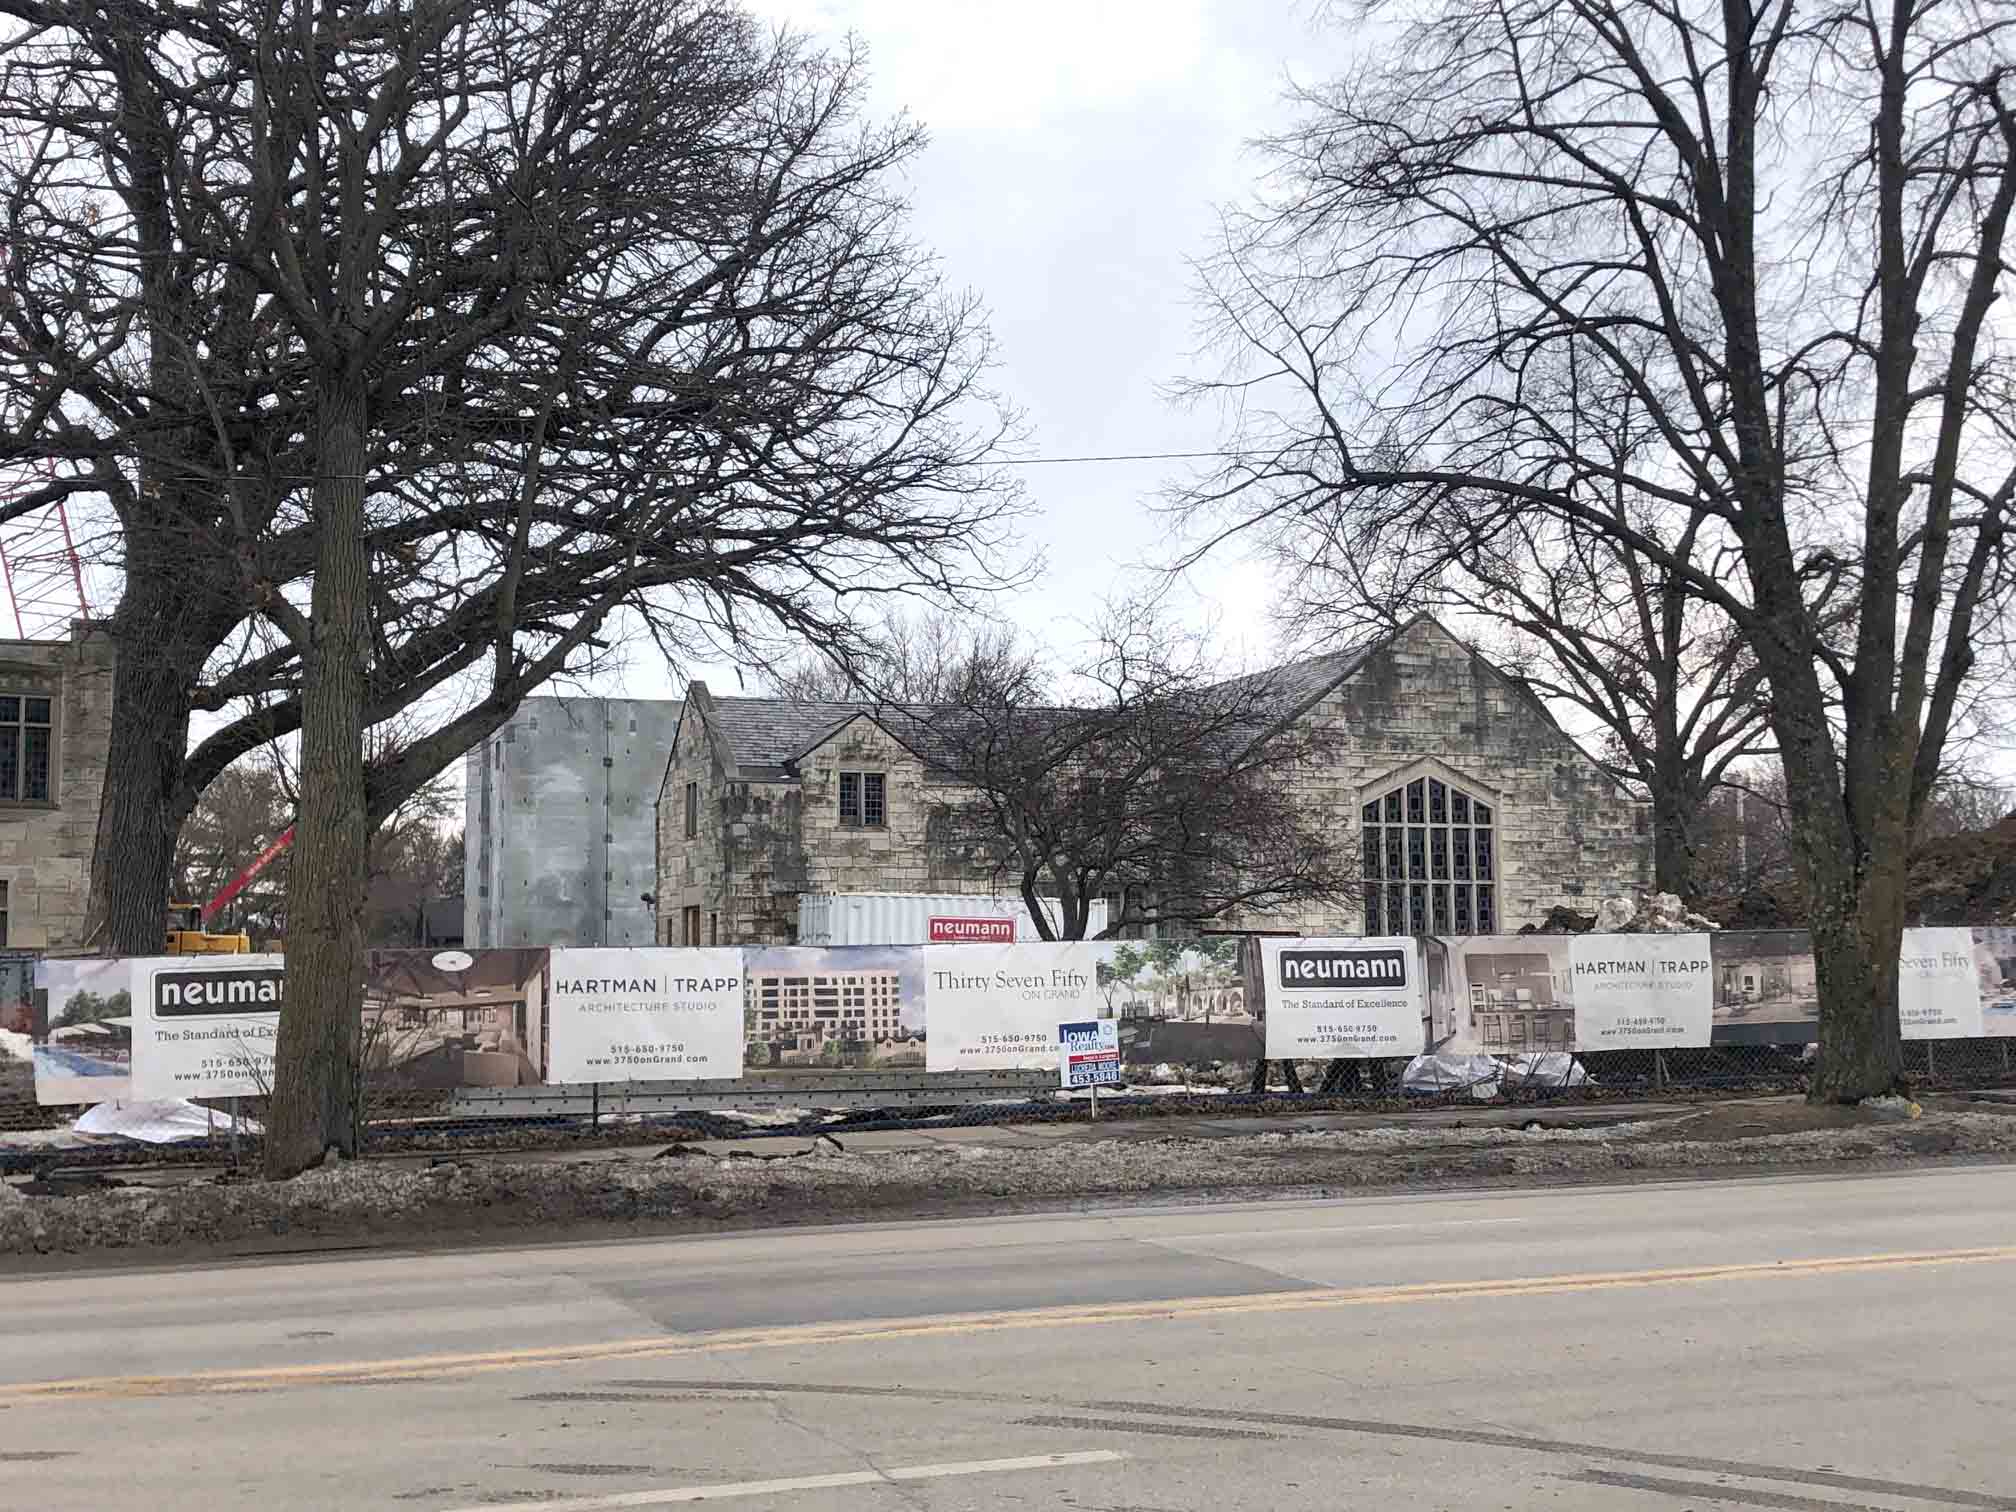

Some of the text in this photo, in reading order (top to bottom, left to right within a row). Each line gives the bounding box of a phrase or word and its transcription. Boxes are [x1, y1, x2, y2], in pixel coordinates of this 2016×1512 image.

[933, 921, 1010, 936] neumann
[1284, 958, 1401, 979] neumann
[1575, 960, 1709, 975] HARTMAN TRAPP
[556, 977, 739, 995] HARTMAN TRAPP
[933, 967, 1089, 993] Thirty Seven Fifty
[161, 978, 284, 1007] neuma
[1021, 988, 1081, 1000] ON GRAND
[578, 1000, 718, 1014] ARCHITECTURE STUDIO
[1281, 998, 1409, 1010] The Standard of Excellence
[154, 1029, 180, 1042] The
[182, 1026, 240, 1041] Standard
[980, 1033, 1048, 1044] 515-650-9750
[959, 1042, 1060, 1056] www.3750onGrand.co
